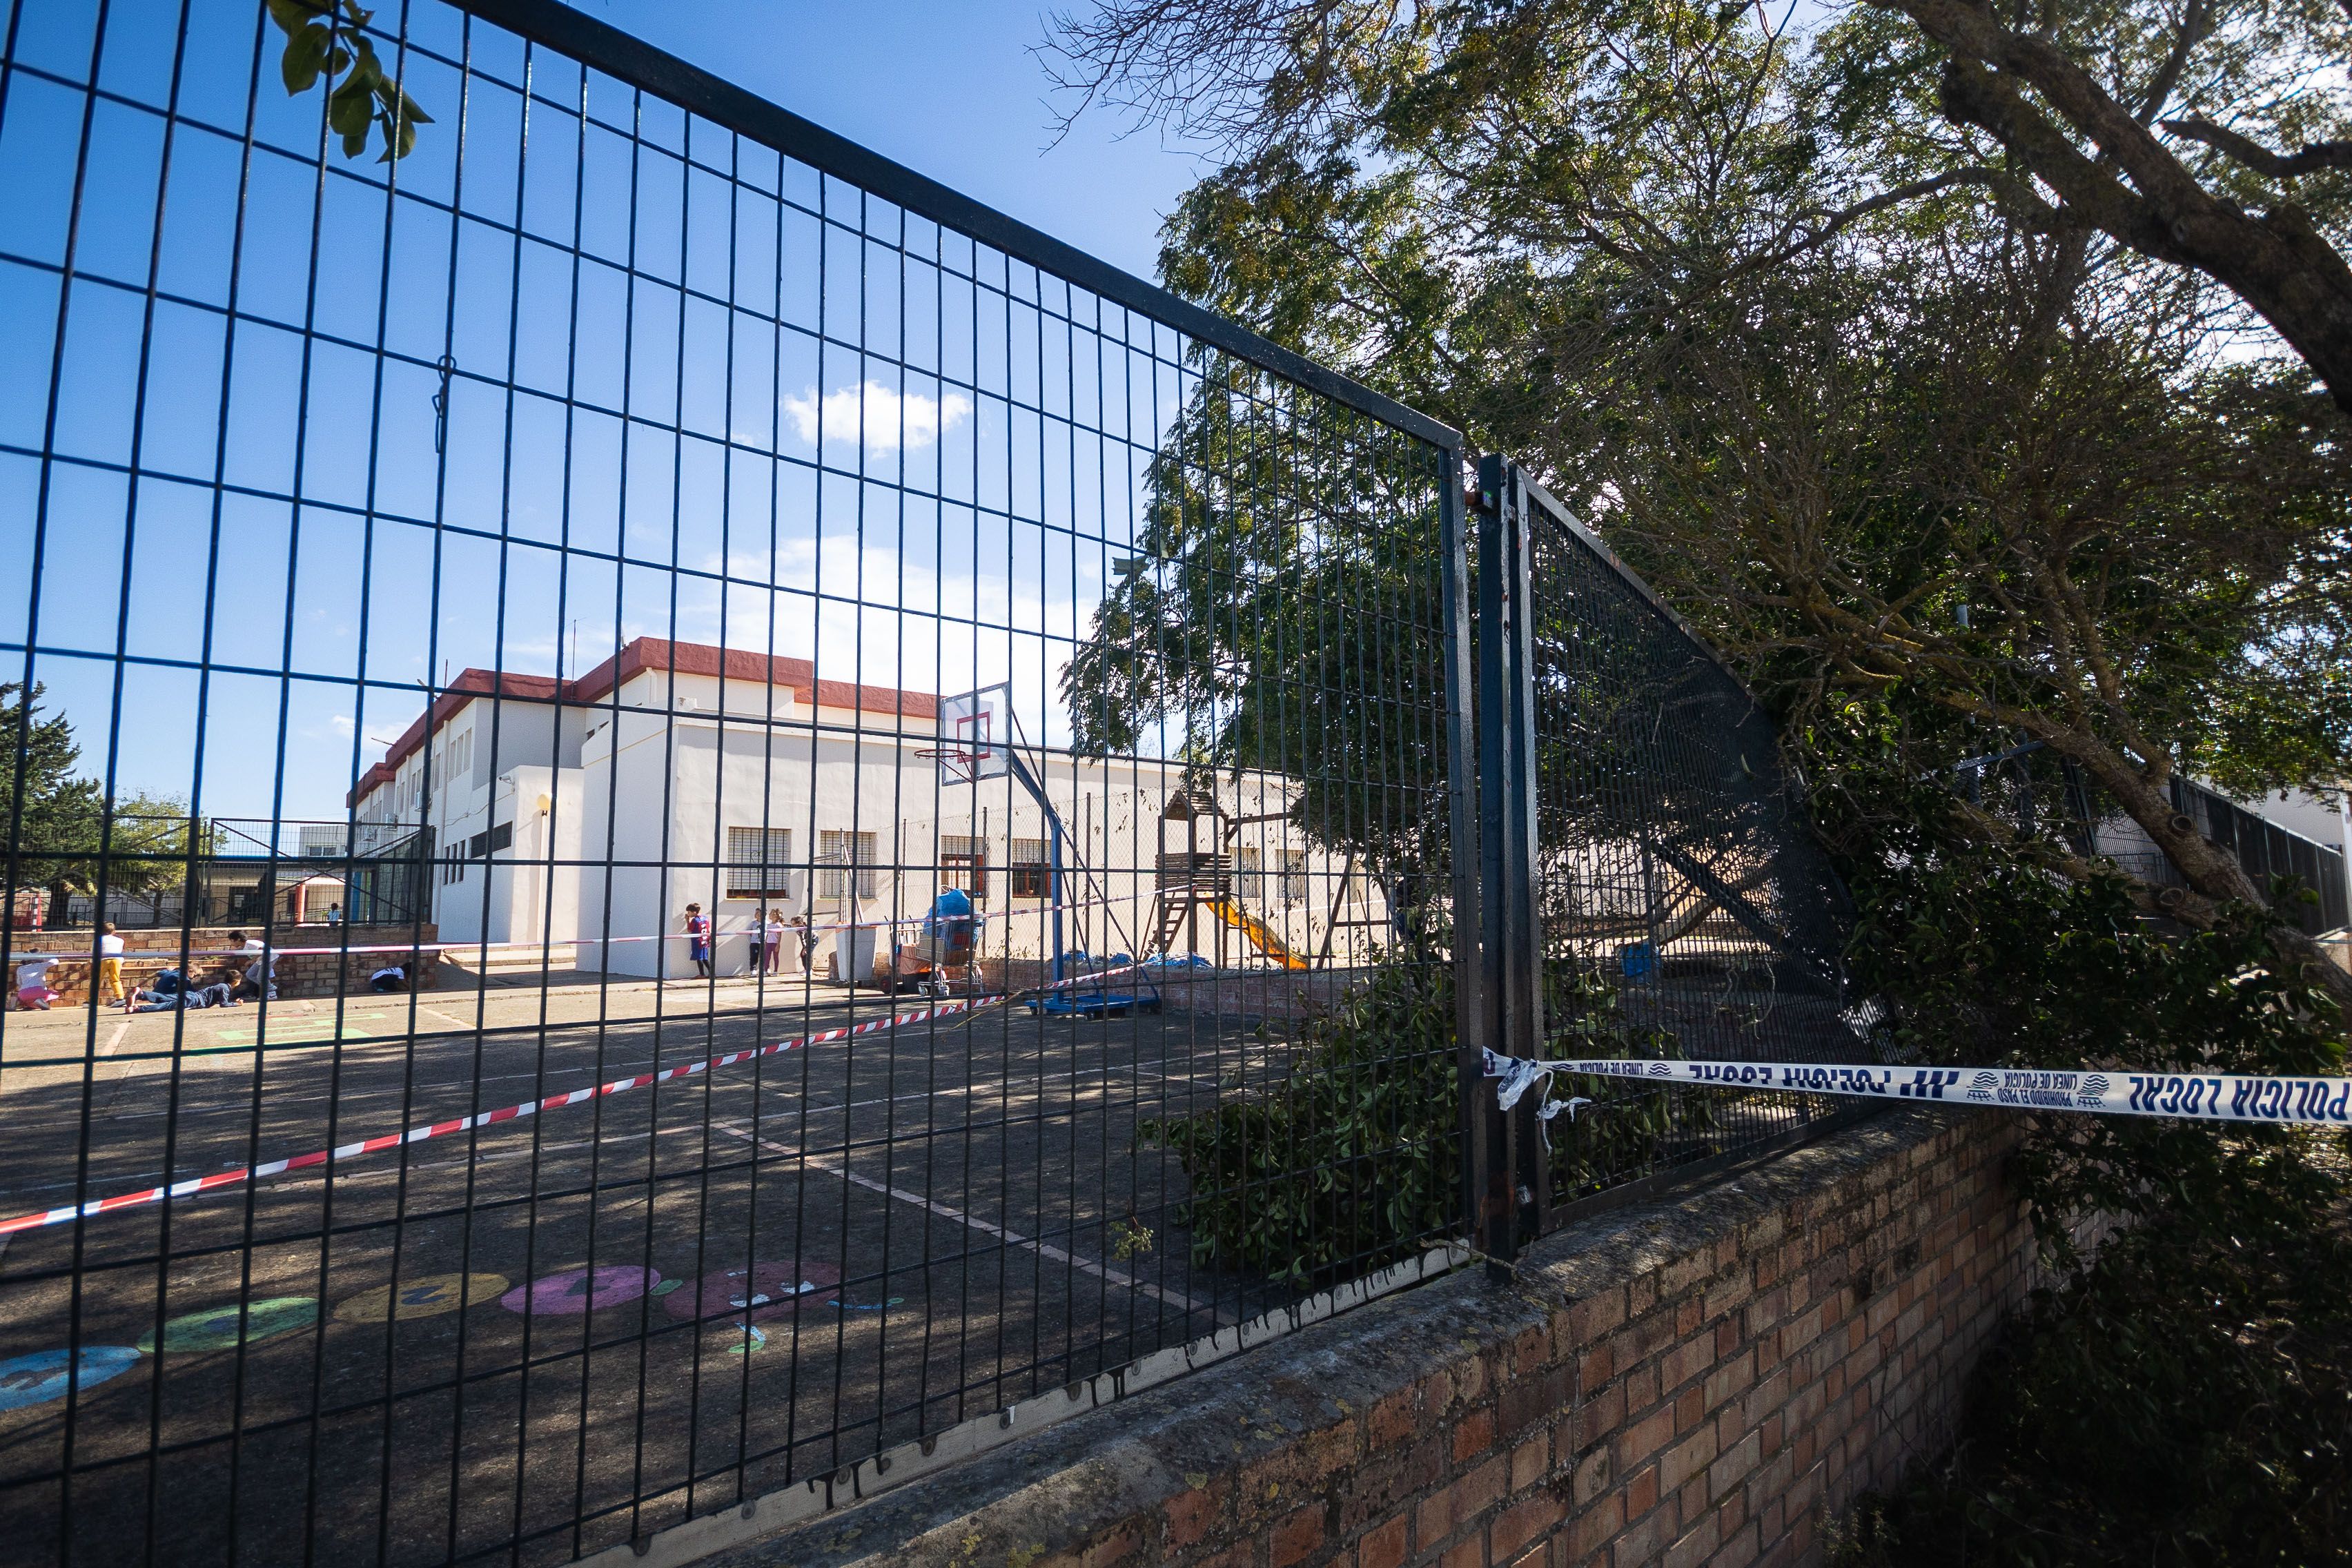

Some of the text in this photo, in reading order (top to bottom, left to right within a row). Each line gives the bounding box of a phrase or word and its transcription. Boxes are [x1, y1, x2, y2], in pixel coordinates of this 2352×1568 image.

[2004, 1072, 2077, 1090] LINEA DE POLICIA
[1997, 1088, 2073, 1107] PROHIBIDO EL PASO
[2129, 1077, 2350, 1121] POLICIA LOCAL
